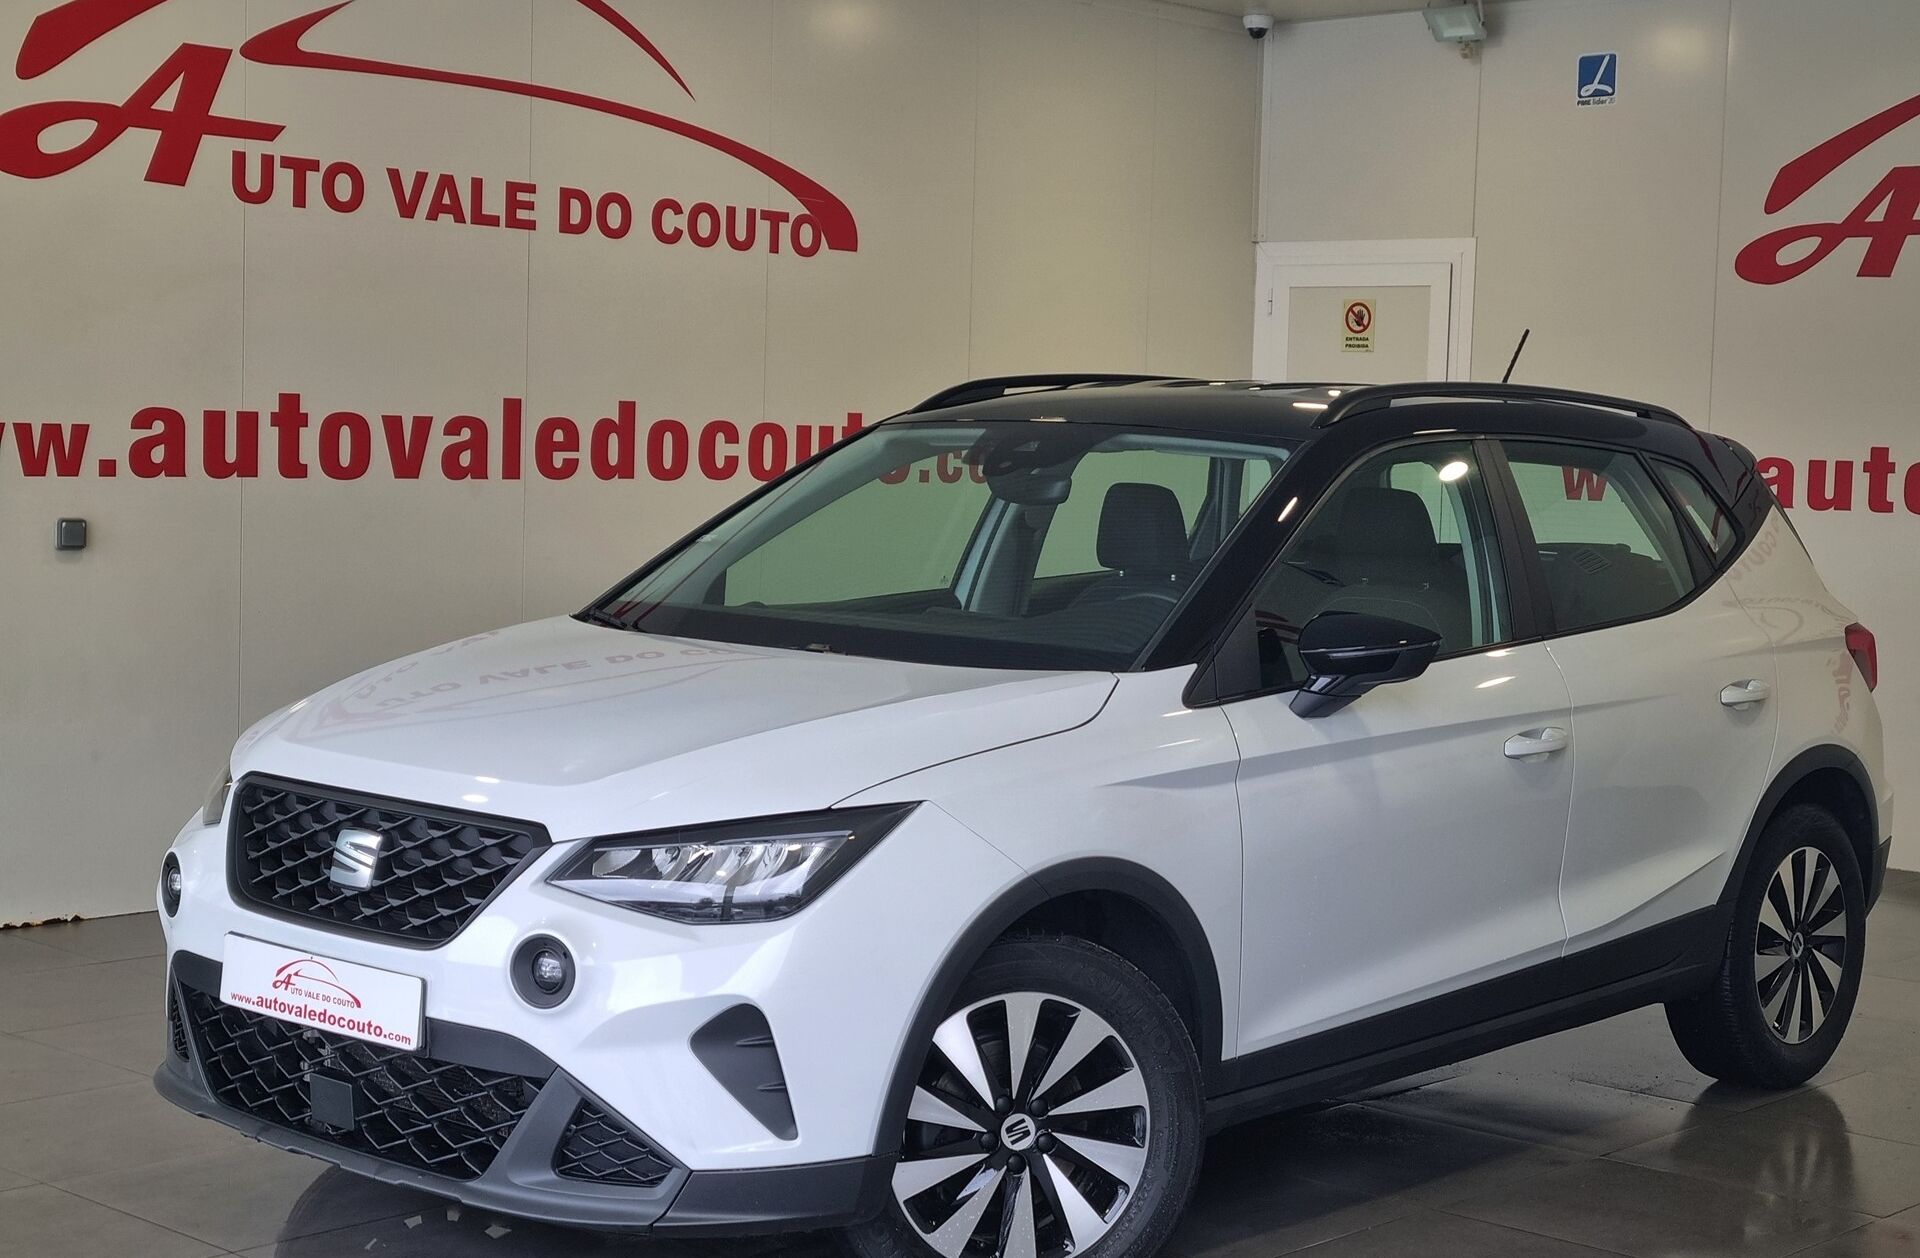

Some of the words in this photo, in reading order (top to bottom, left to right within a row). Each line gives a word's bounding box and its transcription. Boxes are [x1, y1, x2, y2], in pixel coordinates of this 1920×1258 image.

[0, 43, 365, 214] AUTO
[387, 167, 537, 231] VALE
[559, 187, 633, 240] DO
[651, 198, 822, 257] COUTO
[272, 973, 303, 997] AUTO
[304, 989, 321, 1001] VALE
[321, 993, 331, 1003] DO
[332, 996, 355, 1009] COUTO
[230, 992, 412, 1046] www.autovaledocouto.com
